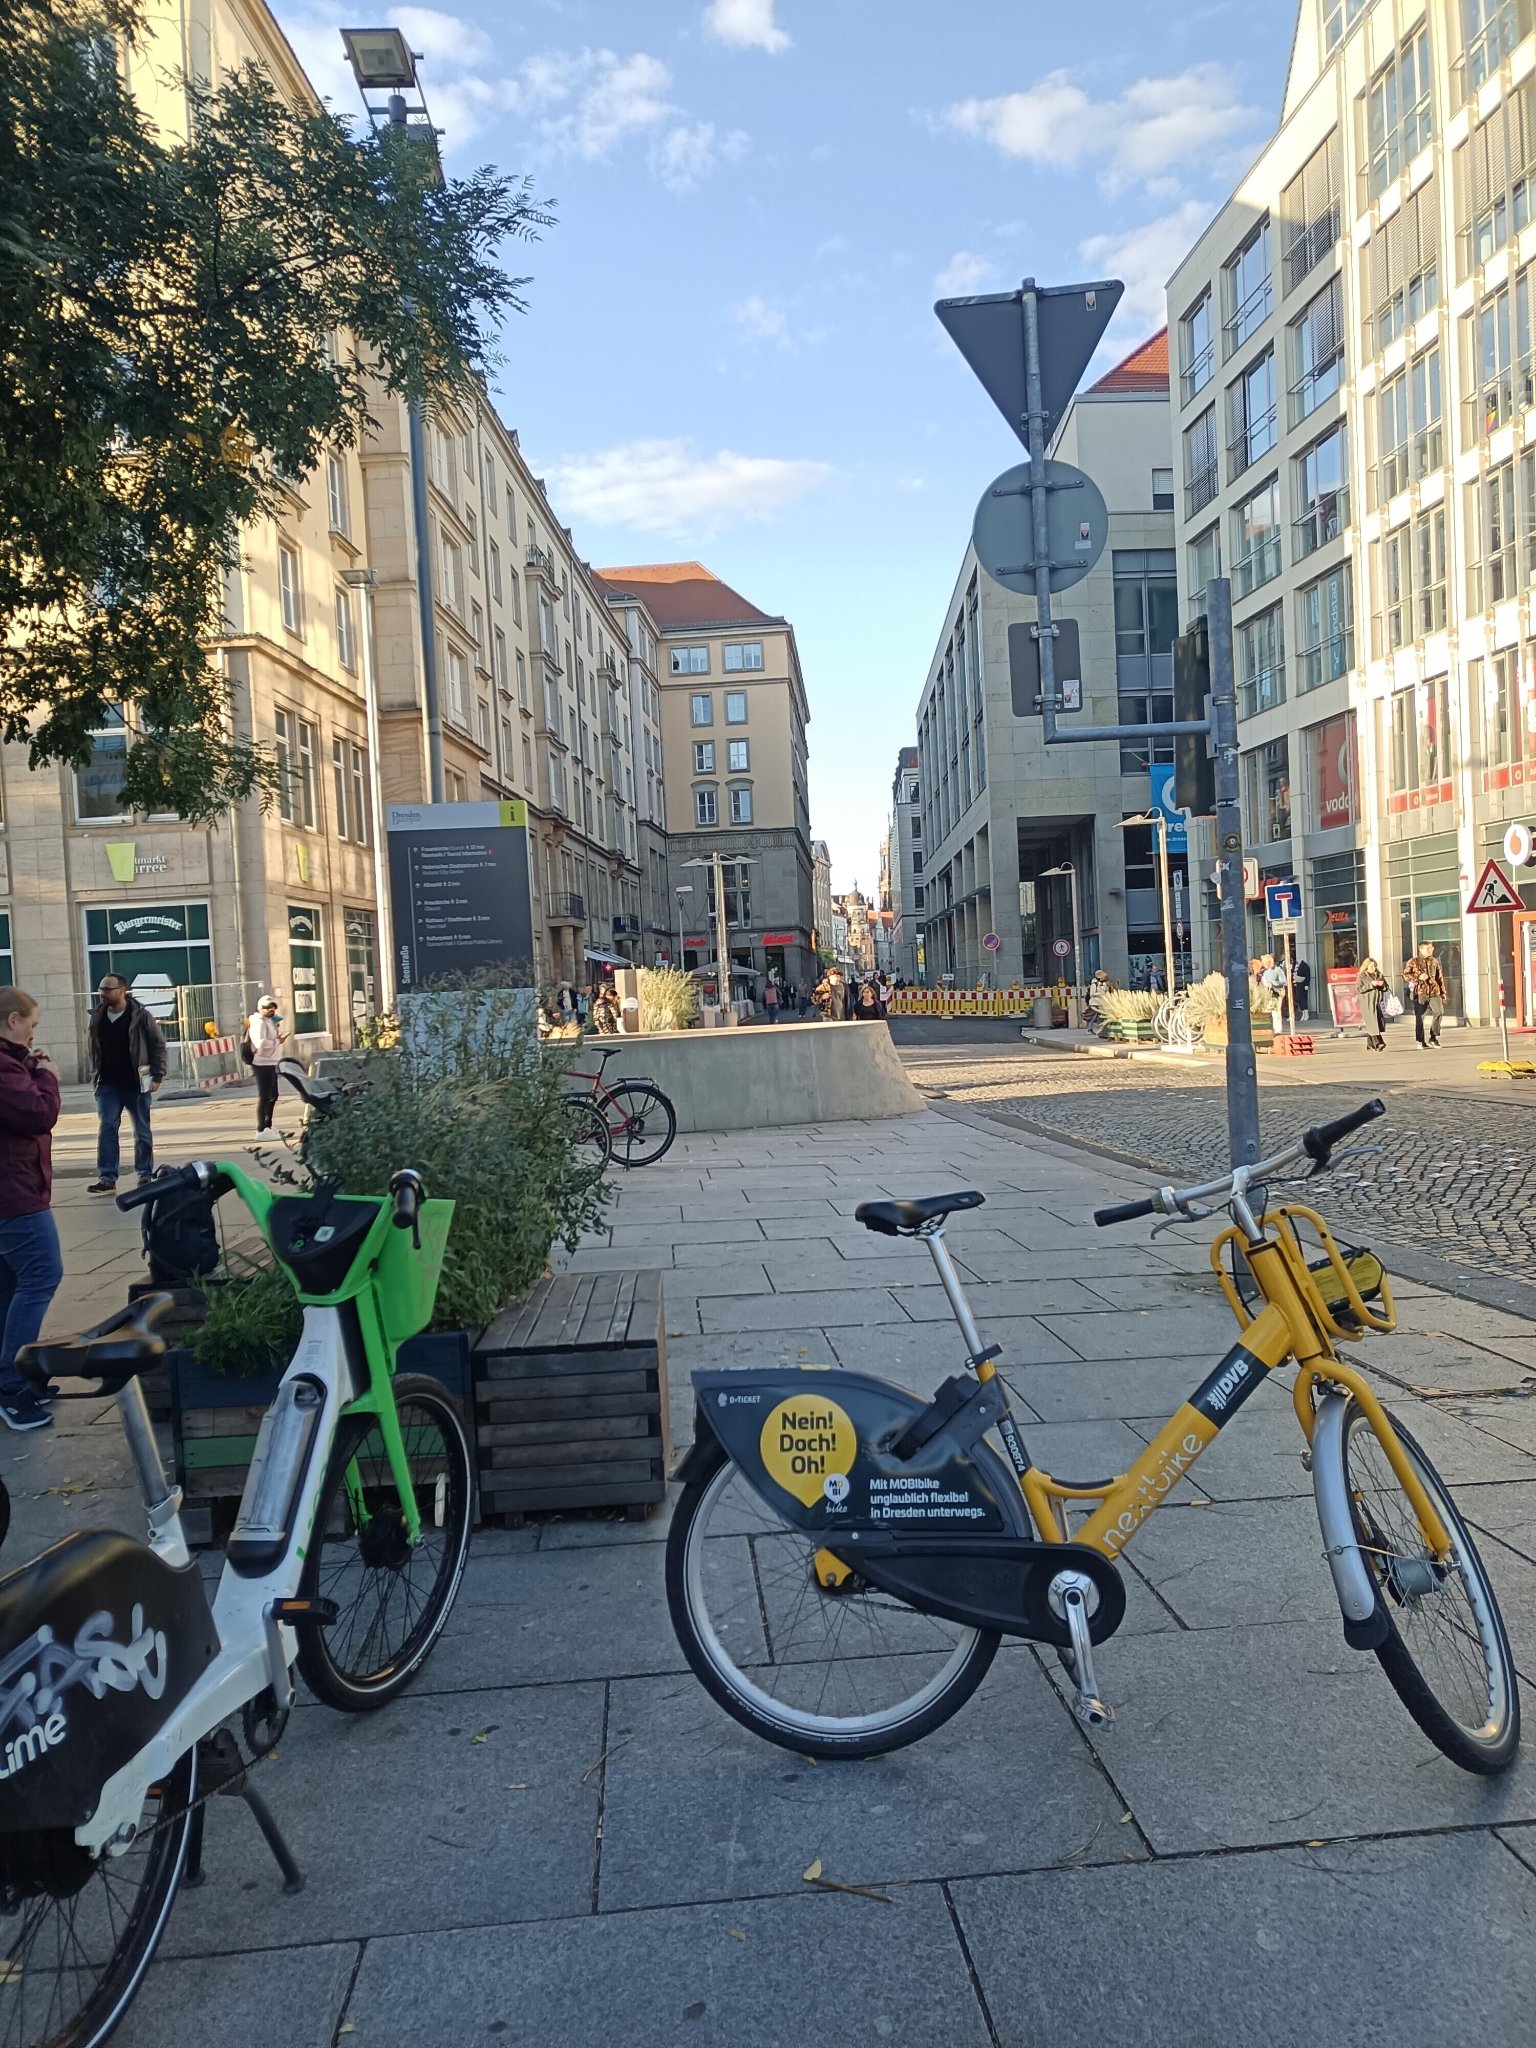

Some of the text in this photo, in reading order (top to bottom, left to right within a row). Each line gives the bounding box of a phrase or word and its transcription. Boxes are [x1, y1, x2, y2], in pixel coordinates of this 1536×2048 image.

[1219, 1359, 1249, 1395] DVB
[781, 1411, 834, 1430] Nein!
[779, 1433, 837, 1453] Doch!
[791, 1455, 826, 1474] Oh!
[869, 1478, 940, 1490] Mit MOBIbike
[870, 1491, 969, 1506] unglaublich flexibel
[870, 1506, 987, 1519] in Dresden unterwegs.
